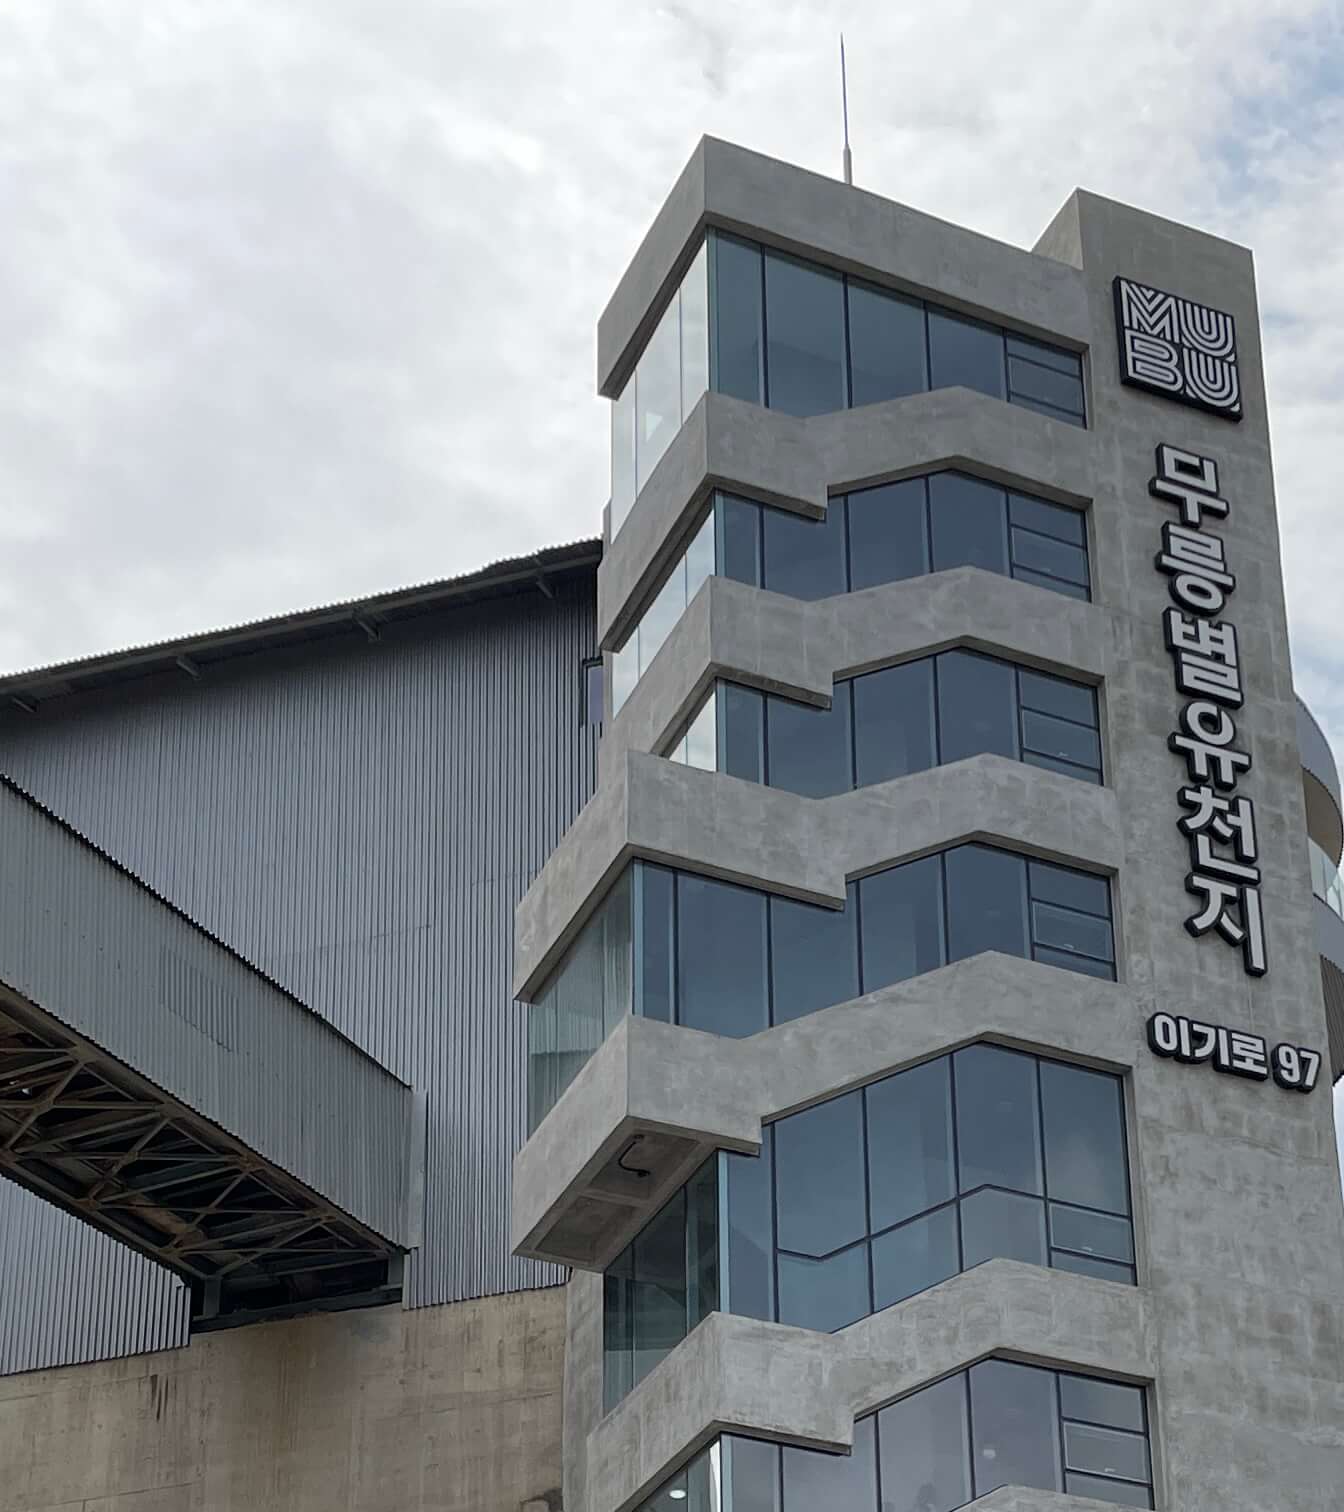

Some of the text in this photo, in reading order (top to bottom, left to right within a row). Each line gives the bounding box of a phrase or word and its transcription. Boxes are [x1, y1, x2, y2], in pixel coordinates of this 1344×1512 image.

[1152, 444, 1267, 974] 무릉별유천지
[1150, 1012, 1321, 1090] 이기로 97
